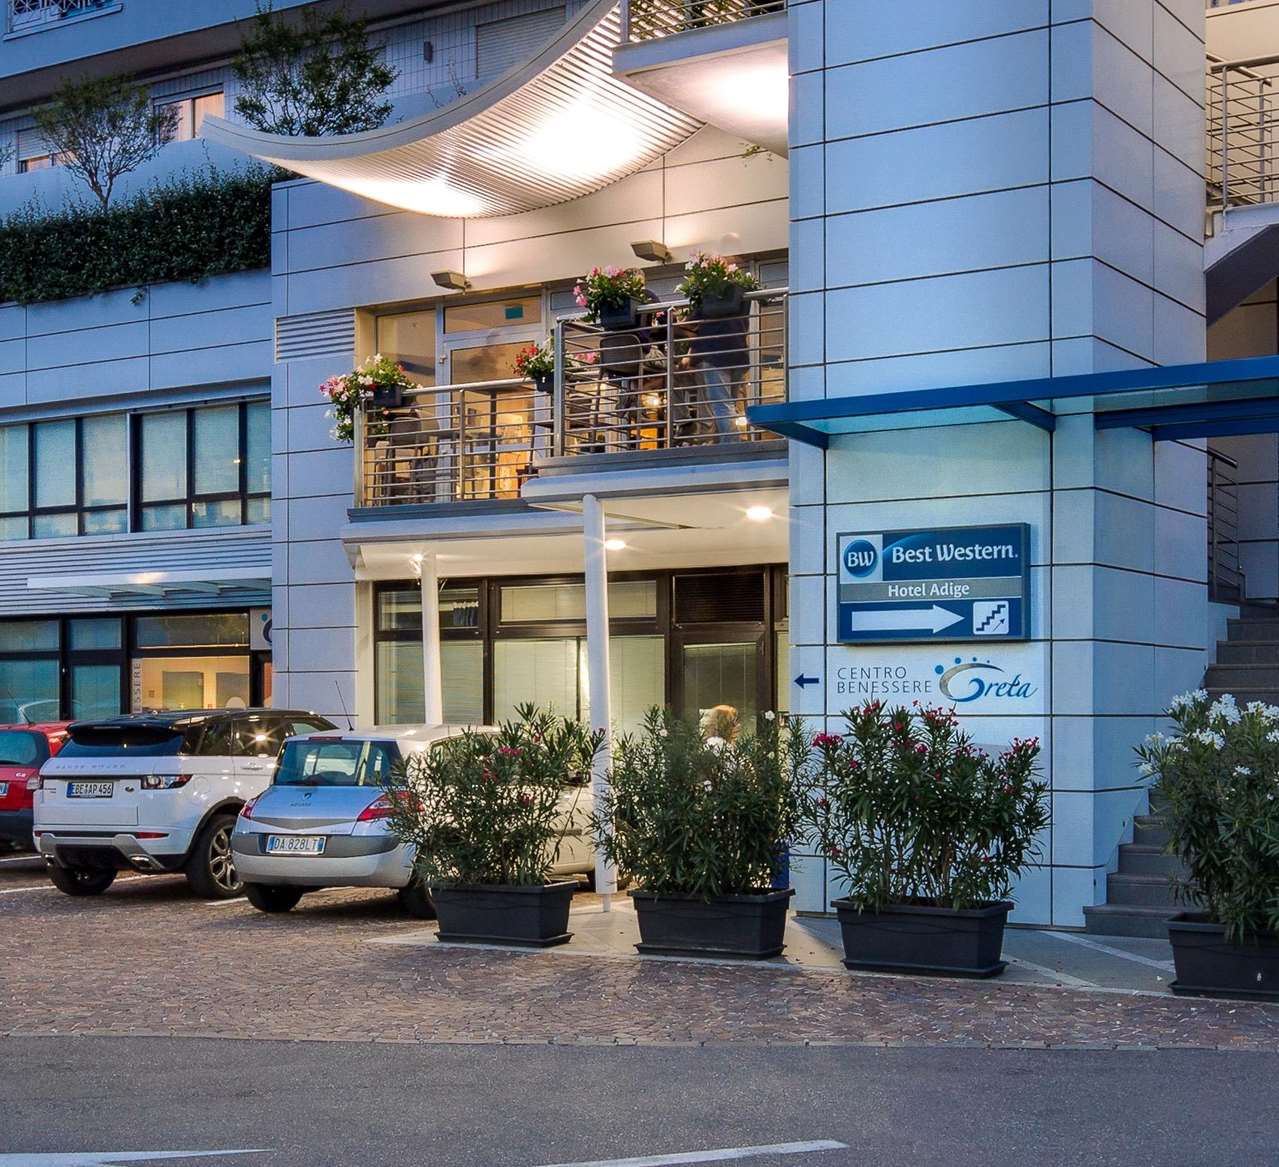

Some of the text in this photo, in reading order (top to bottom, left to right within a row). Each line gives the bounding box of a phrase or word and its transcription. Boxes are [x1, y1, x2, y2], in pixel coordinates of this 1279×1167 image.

[847, 549, 875, 568] BW
[892, 546, 932, 564] Best
[888, 582, 970, 598] Hotel Adige
[837, 666, 907, 680] CENTRO
[837, 680, 933, 694] BENESSERE
[939, 662, 1039, 703] Greta
